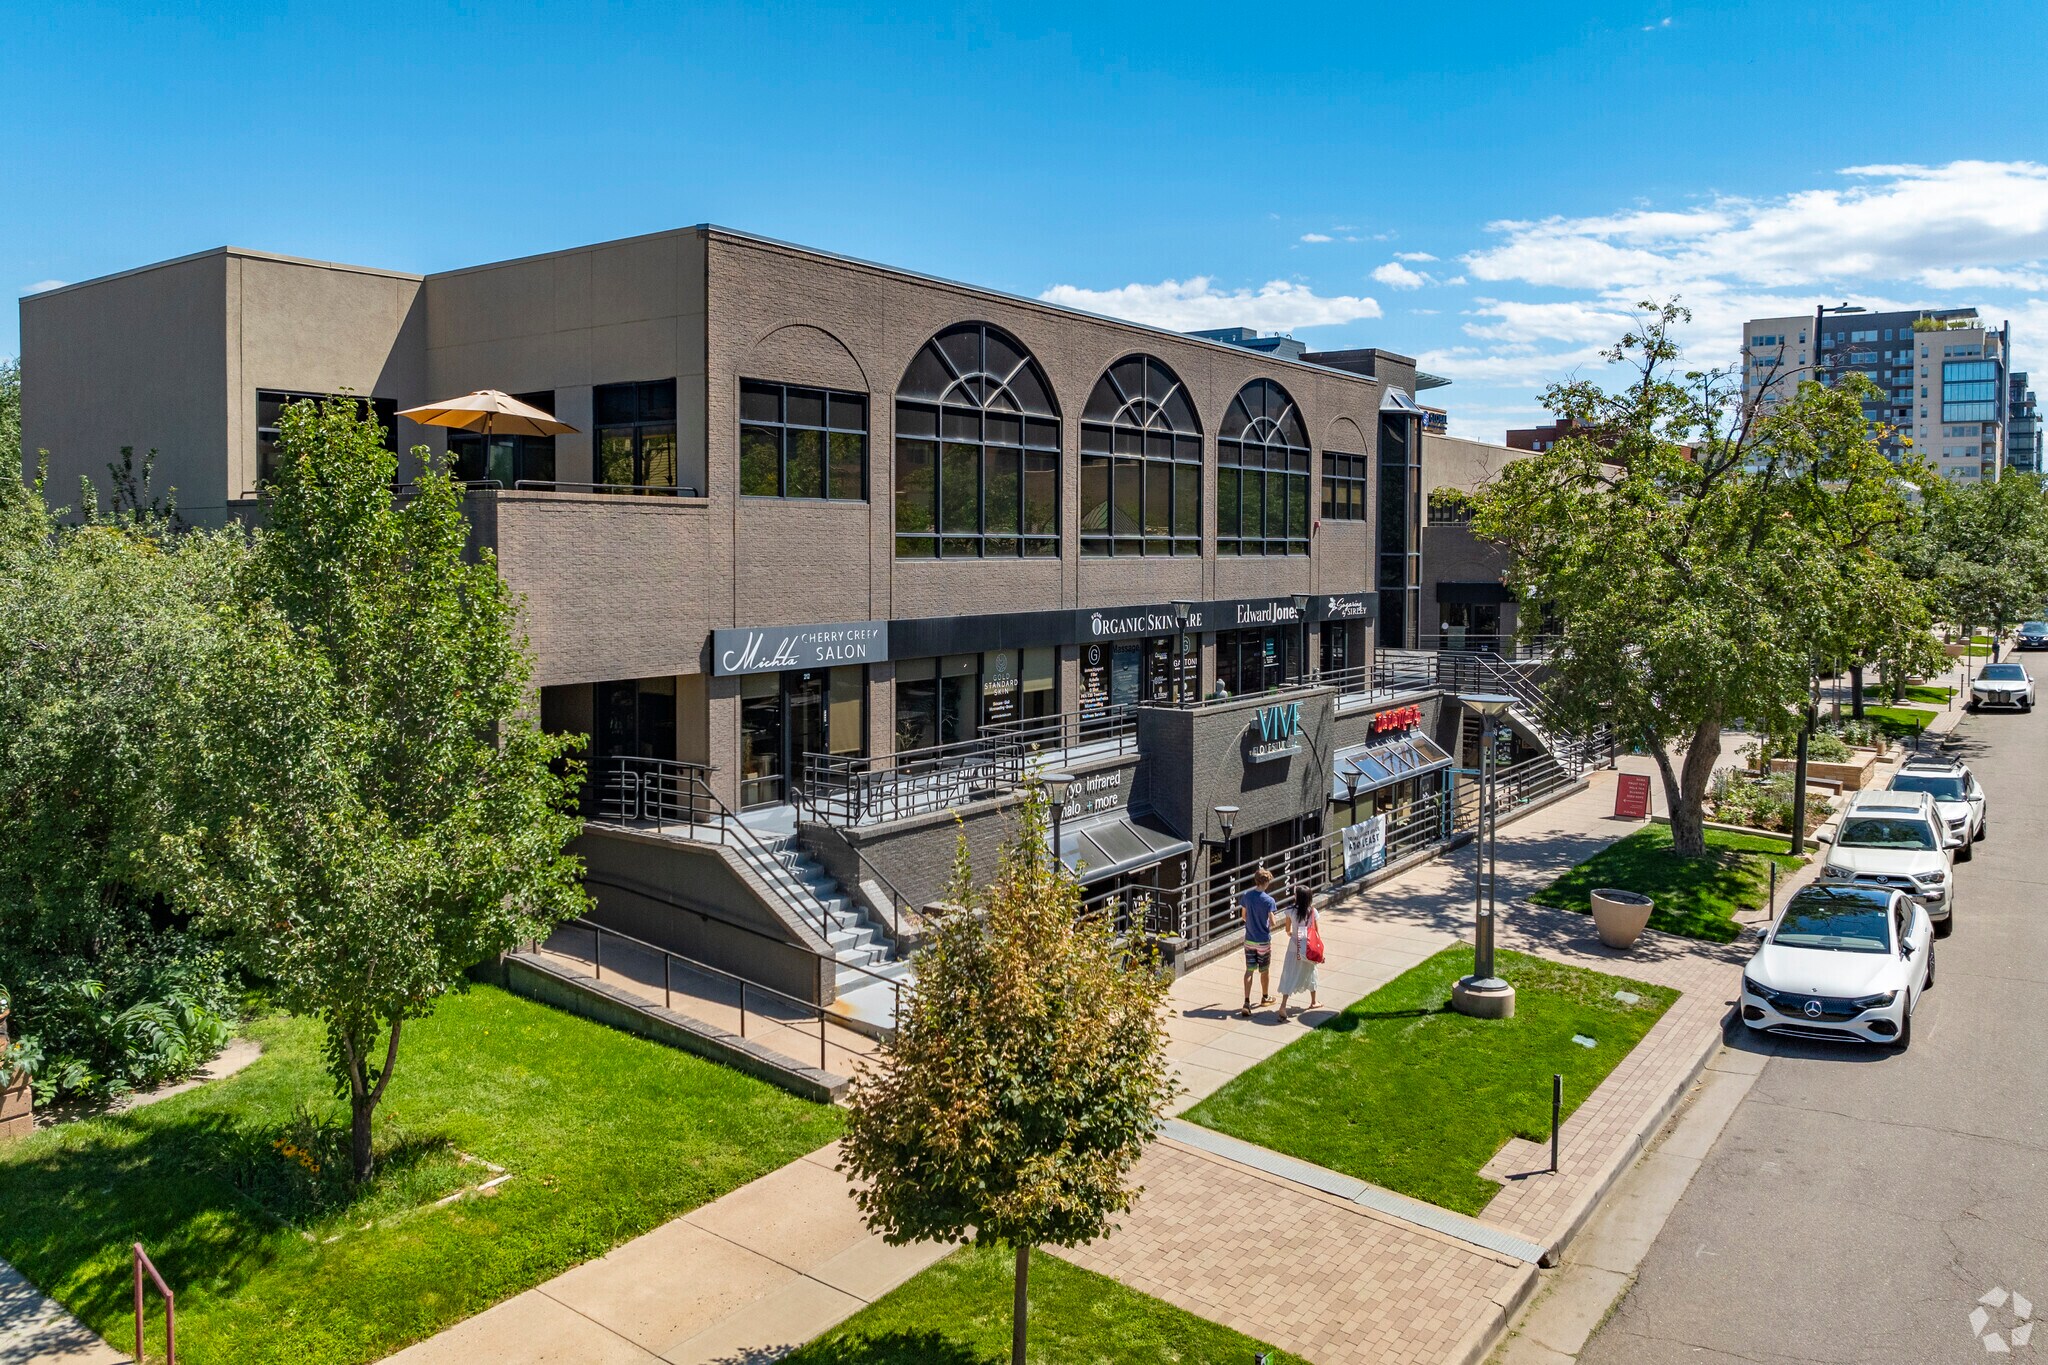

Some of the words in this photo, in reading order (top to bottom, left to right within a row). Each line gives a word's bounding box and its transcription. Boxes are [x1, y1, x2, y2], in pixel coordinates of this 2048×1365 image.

[1237, 602, 1272, 624] Edward
[1091, 616, 1145, 636] ORGANIC
[1147, 613, 1174, 631] SKIN
[801, 631, 845, 644] CHERRY
[816, 644, 867, 661] SALON
[984, 678, 1019, 690] STANDARD
[992, 672, 1011, 682] GOLD
[993, 688, 1009, 696] SKIN
[1086, 769, 1121, 791] infrared
[1095, 793, 1118, 810] more
